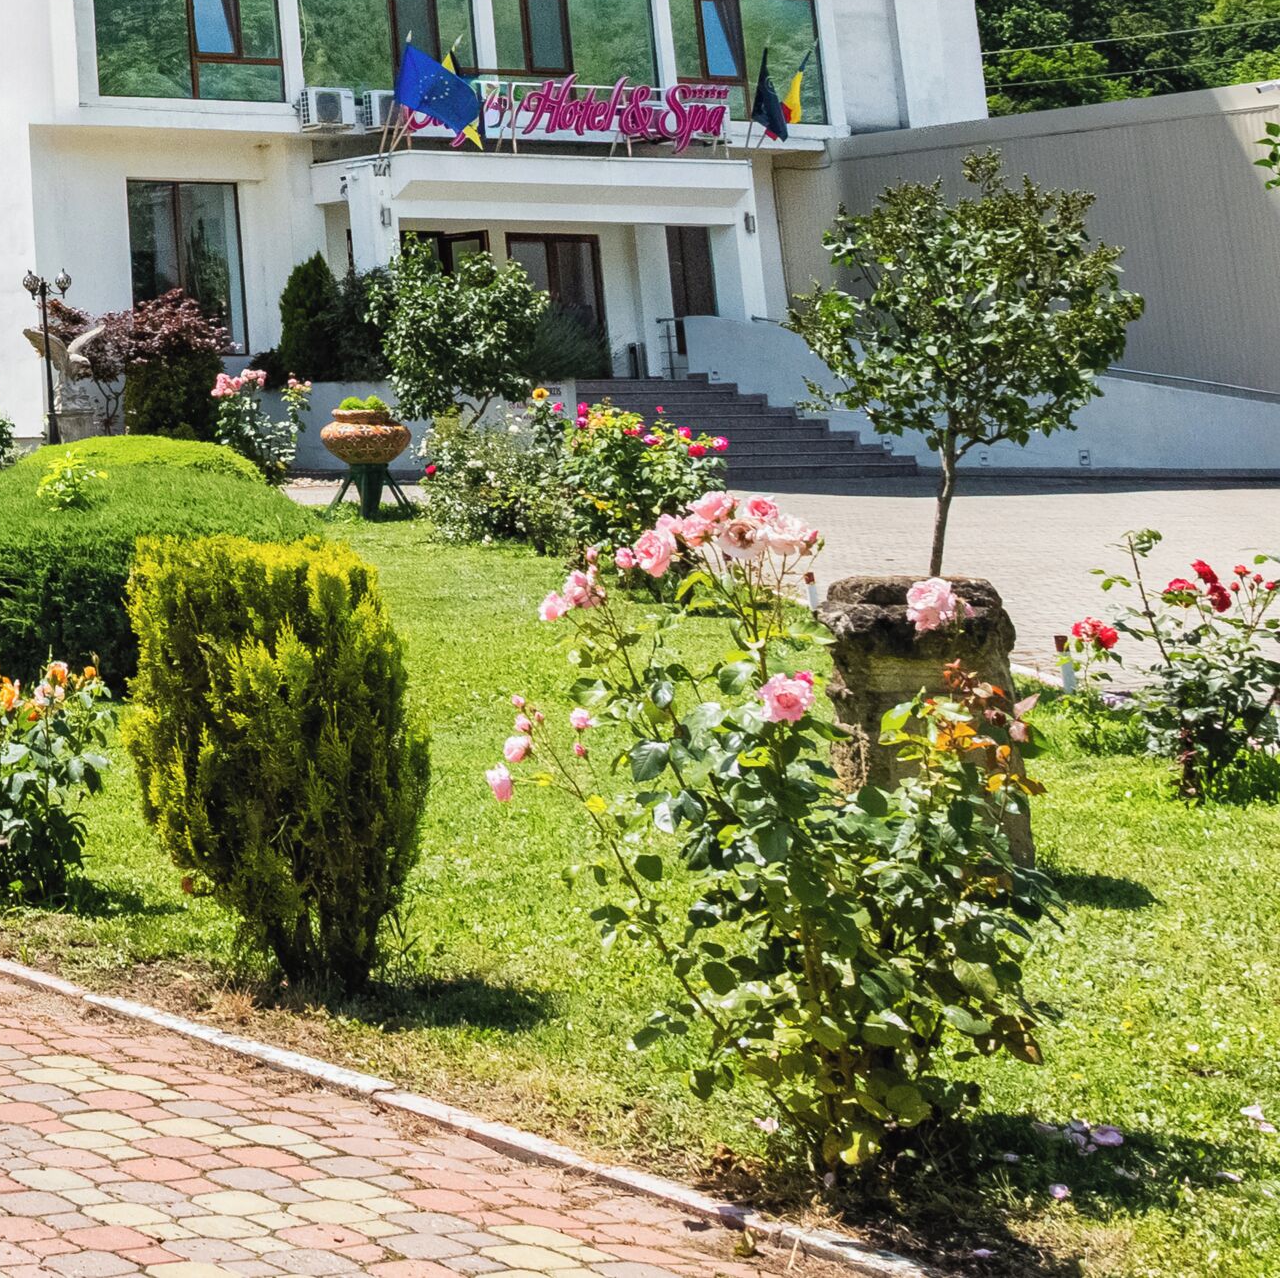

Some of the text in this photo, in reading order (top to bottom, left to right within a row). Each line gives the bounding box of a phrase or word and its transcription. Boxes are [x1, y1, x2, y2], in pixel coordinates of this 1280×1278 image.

[522, 73, 630, 136] Hotel
[618, 85, 653, 136] &
[656, 83, 727, 154] Spa
